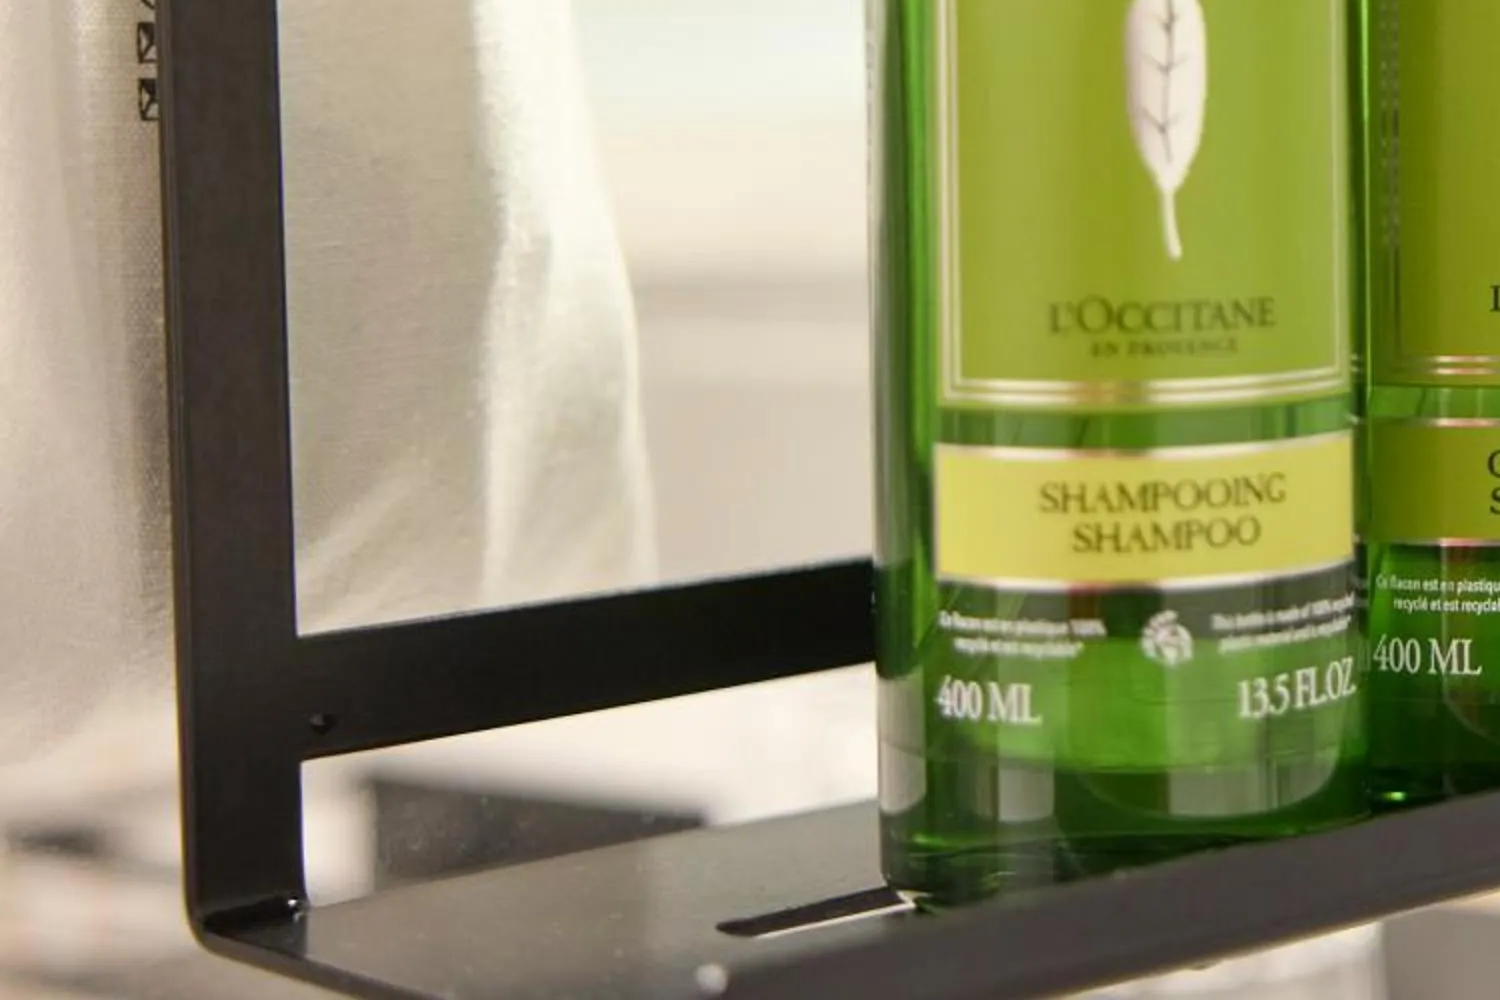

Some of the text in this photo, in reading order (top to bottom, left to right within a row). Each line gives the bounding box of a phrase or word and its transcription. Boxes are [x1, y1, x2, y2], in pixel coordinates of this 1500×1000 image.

[1048, 296, 1276, 335] L'OCCITANE
[1039, 472, 1287, 515] SHAMPOOING
[1072, 516, 1261, 554] SHAMPOO
[1373, 634, 1421, 674] 400
[1428, 638, 1482, 676] ML
[935, 675, 1042, 726] 400 ML
